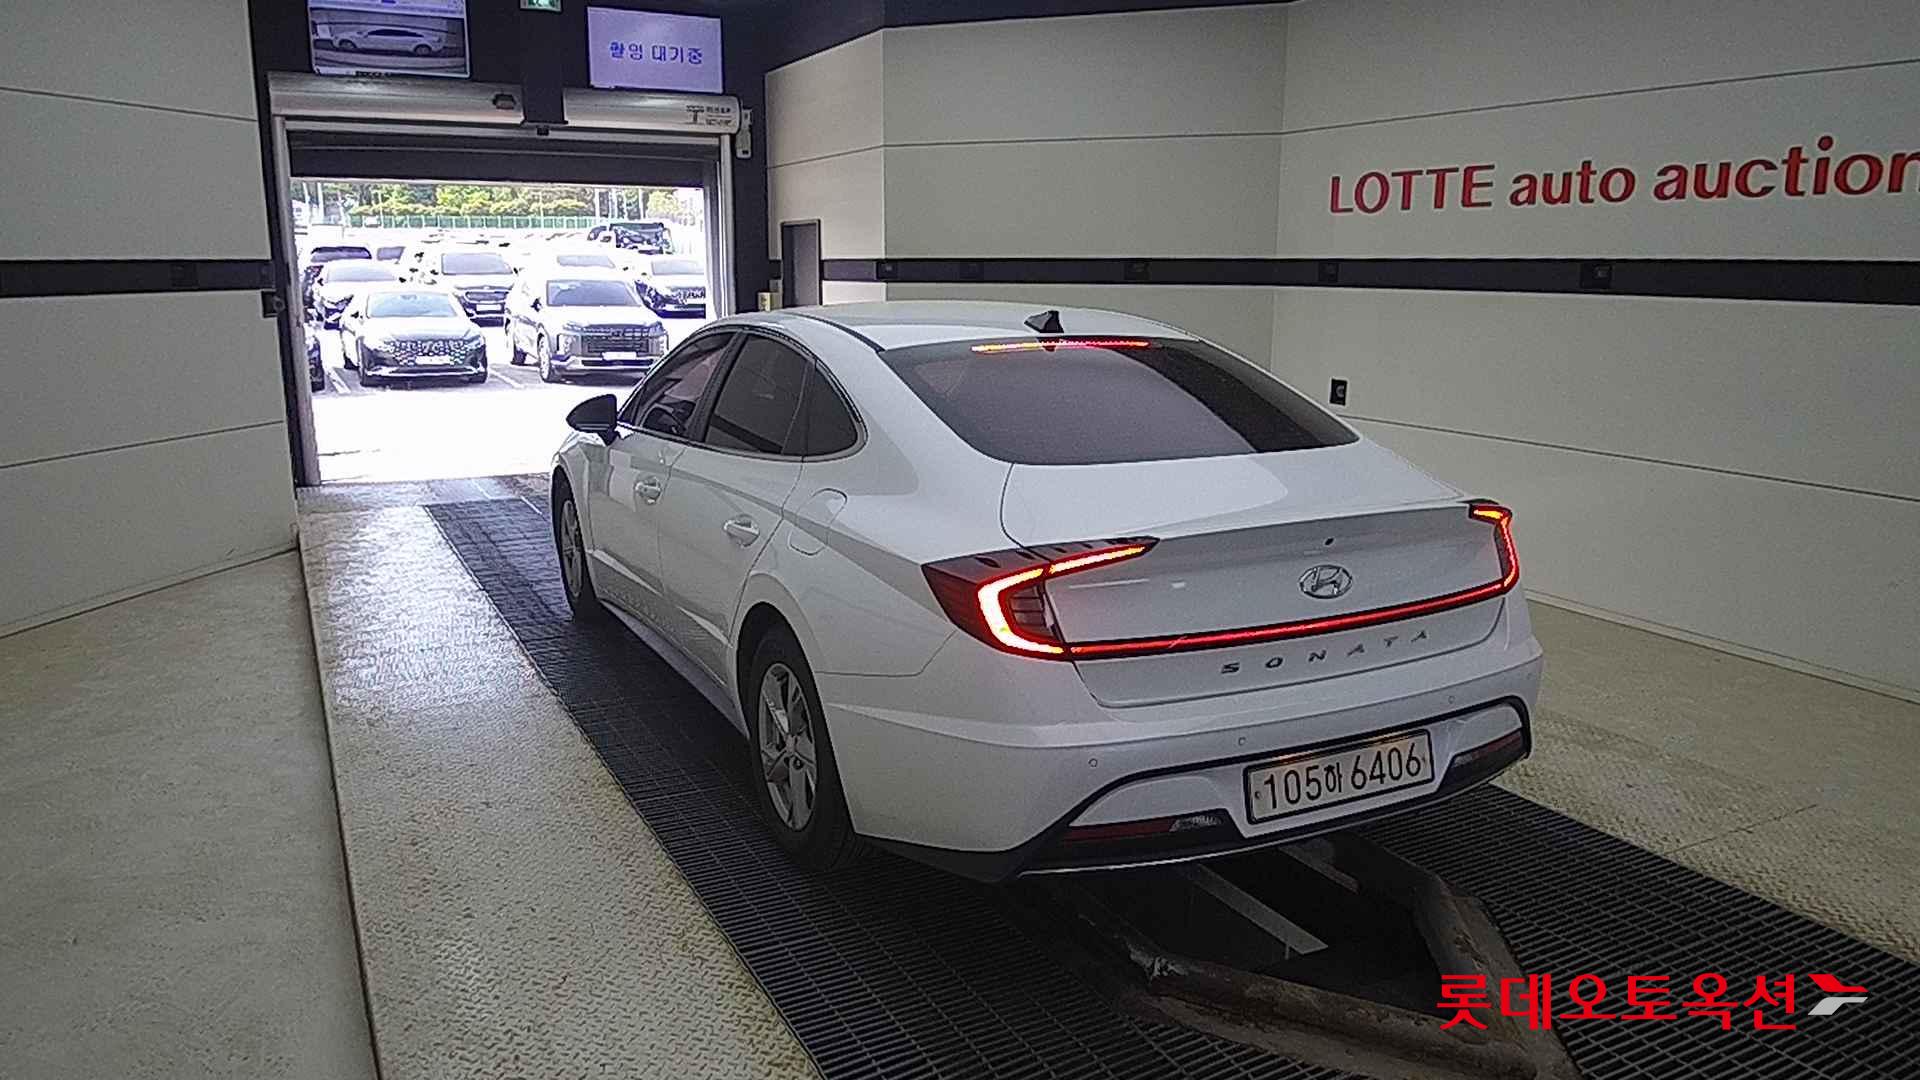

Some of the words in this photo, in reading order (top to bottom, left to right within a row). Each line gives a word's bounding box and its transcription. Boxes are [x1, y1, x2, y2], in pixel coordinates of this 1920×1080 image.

[652, 44, 703, 65] 대기중
[1330, 164, 1495, 213] LOTTE
[1509, 160, 1636, 206] auto
[1221, 630, 1427, 674] SONATA
[1352, 743, 1421, 790] 6406
